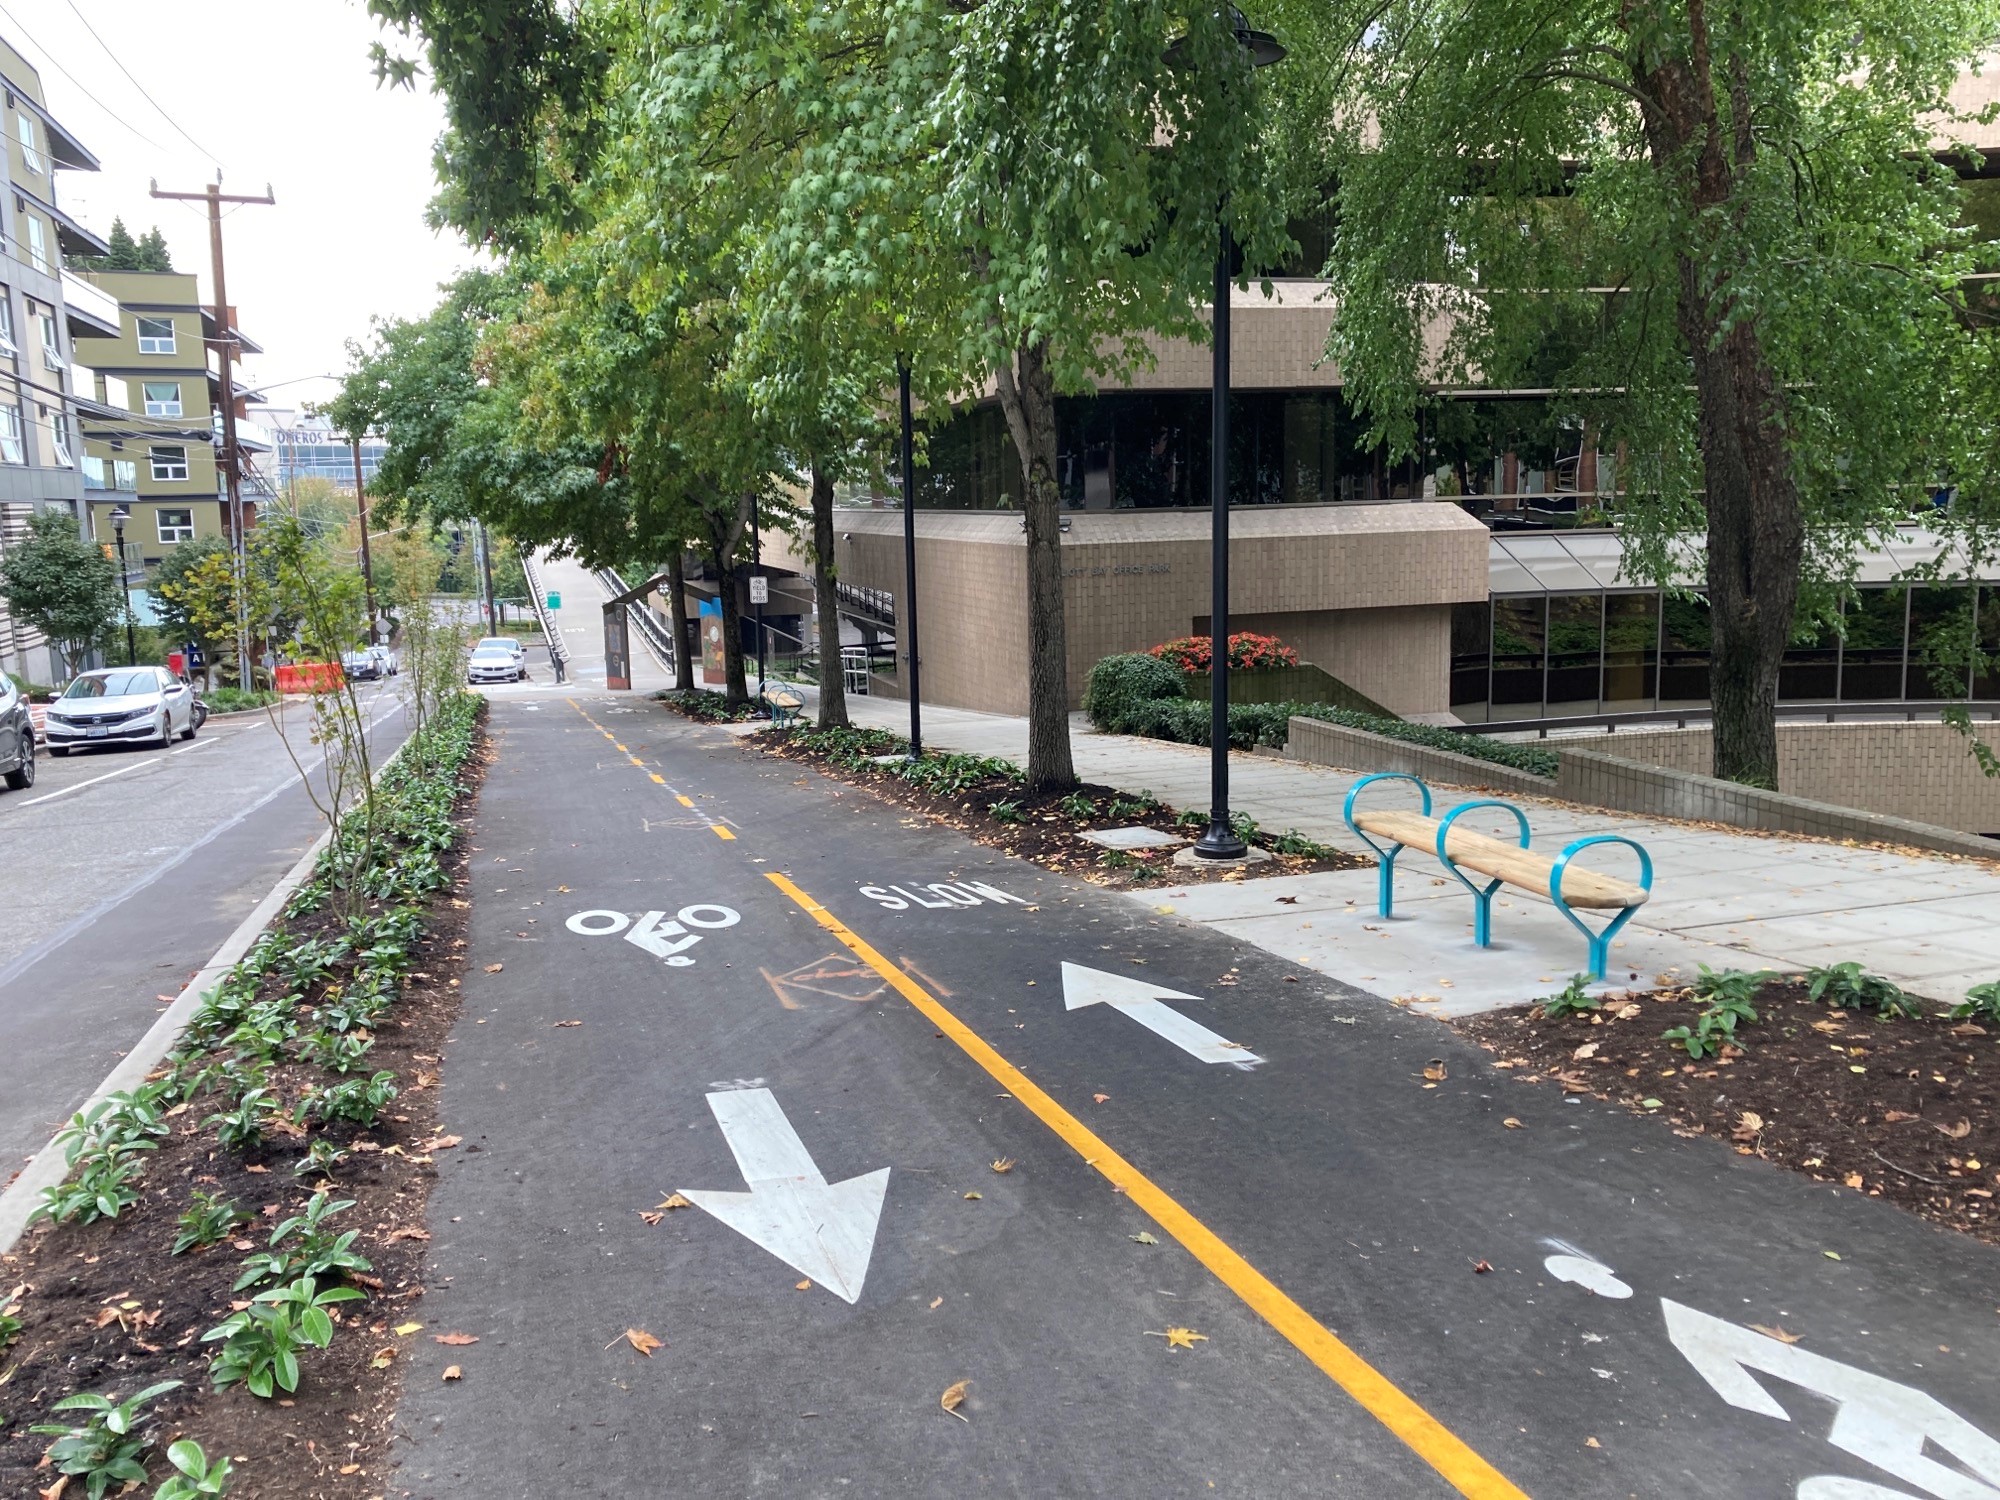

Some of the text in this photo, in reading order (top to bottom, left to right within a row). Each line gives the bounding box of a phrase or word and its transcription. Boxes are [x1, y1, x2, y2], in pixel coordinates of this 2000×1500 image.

[277, 431, 323, 444] OMEROS
[1091, 566, 1108, 576] BAY
[1113, 564, 1143, 575] OFFICE
[1148, 562, 1171, 574] PARK
[859, 881, 1029, 910] SLOW
